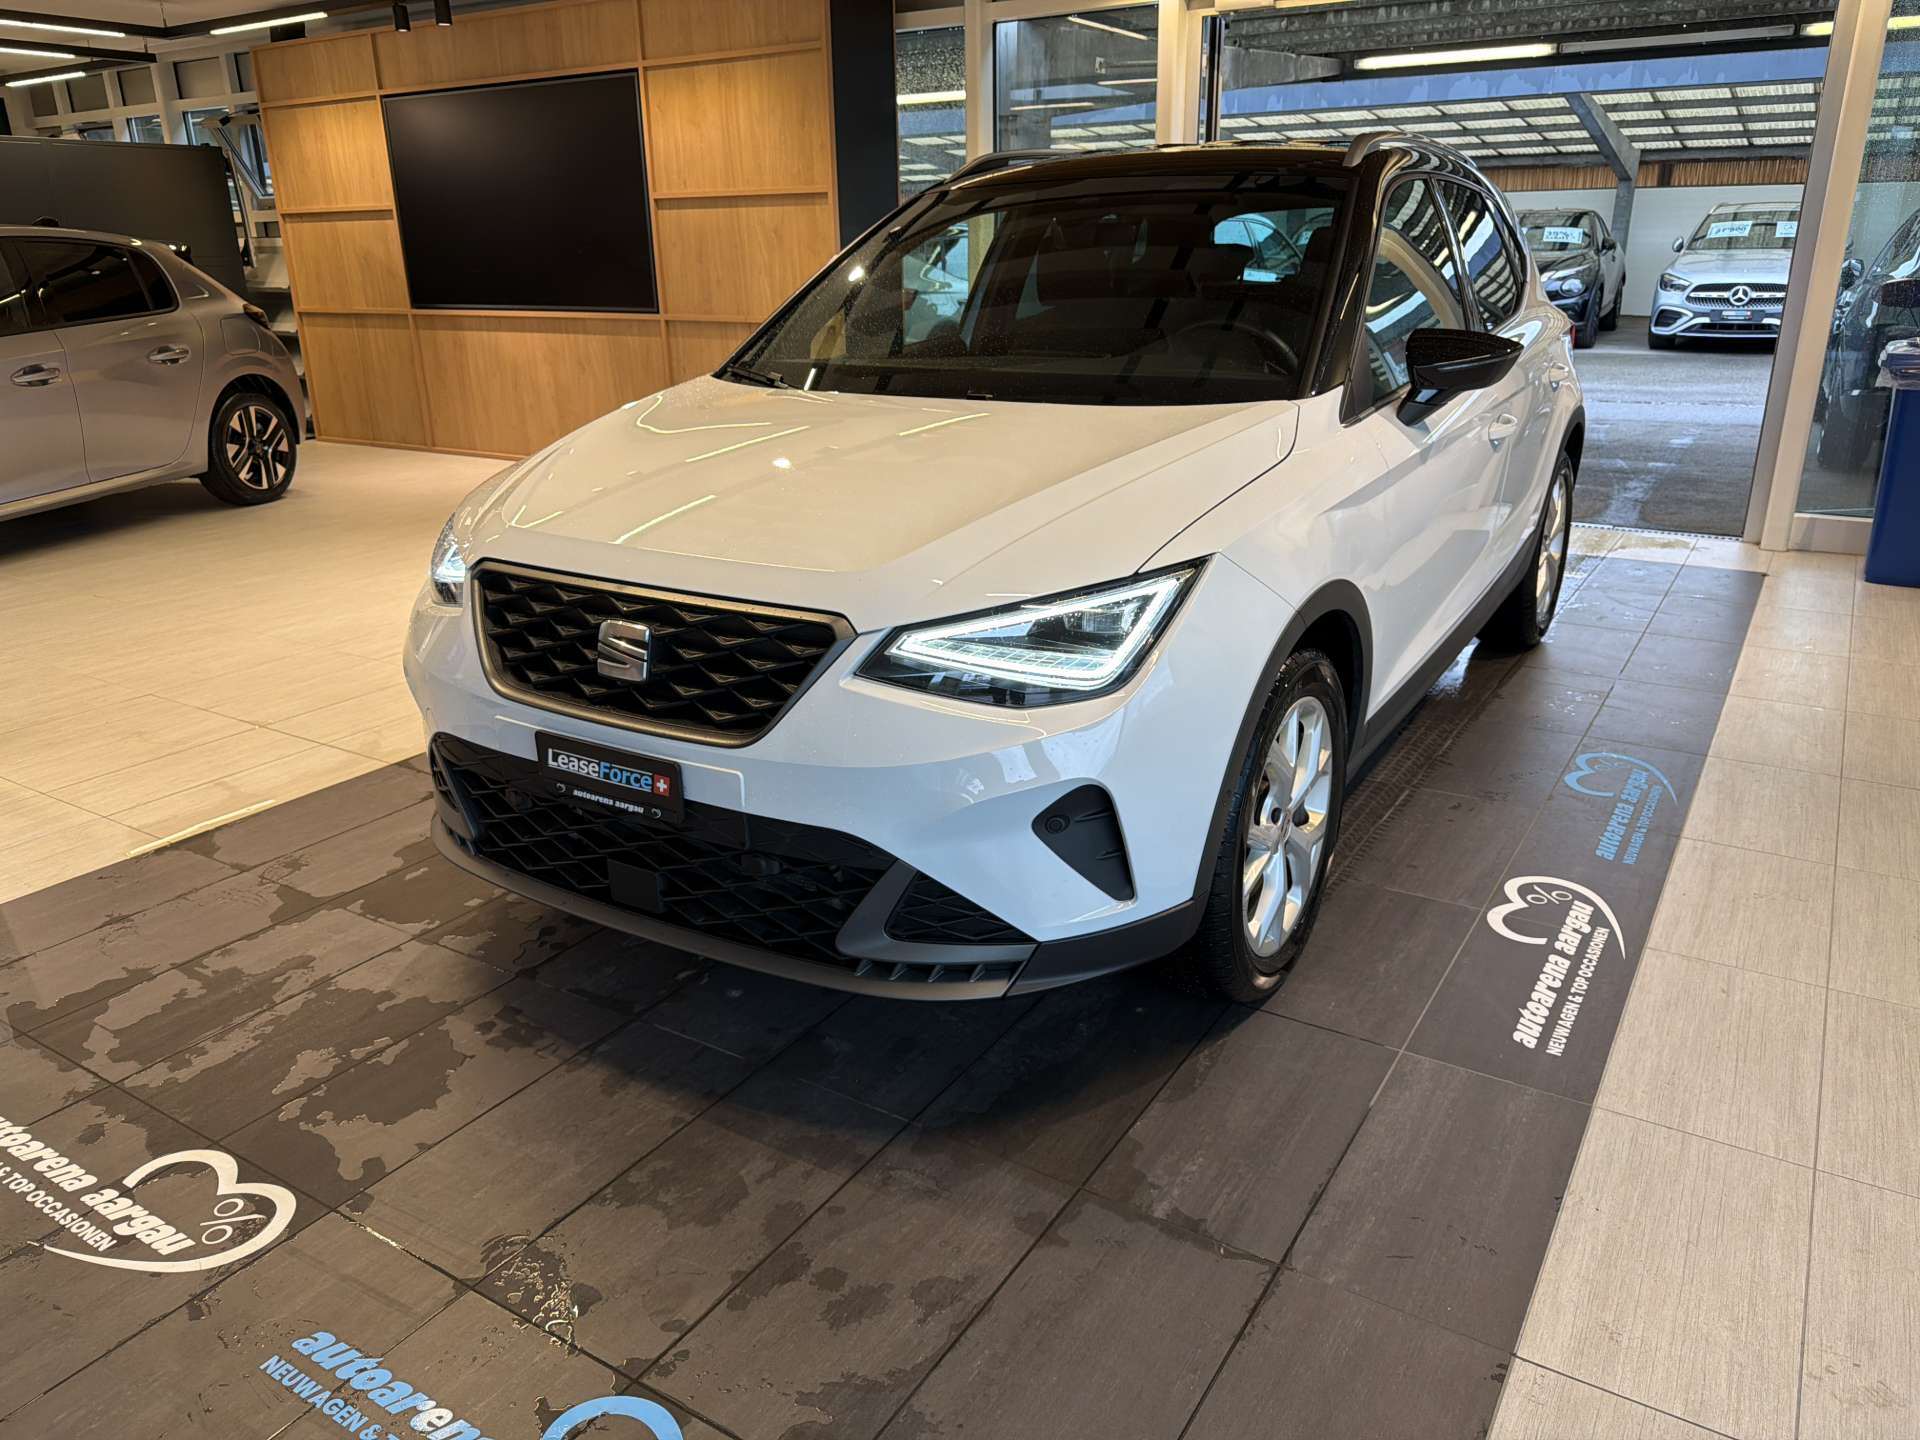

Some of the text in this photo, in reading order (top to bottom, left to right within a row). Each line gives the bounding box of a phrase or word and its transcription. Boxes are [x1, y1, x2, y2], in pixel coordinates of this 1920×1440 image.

[548, 748, 653, 790] LeaseForce
[572, 789, 645, 814] autoarena aargau
[1512, 900, 1594, 1049] autoarena aargau
[1545, 926, 1611, 1057] NEUWAGEN & TOP OCCASIONEN
[1, 1172, 118, 1252] TOP OCCASIONEN
[79, 1188, 196, 1256] aargau
[259, 1355, 369, 1433] NEUWAGEN
